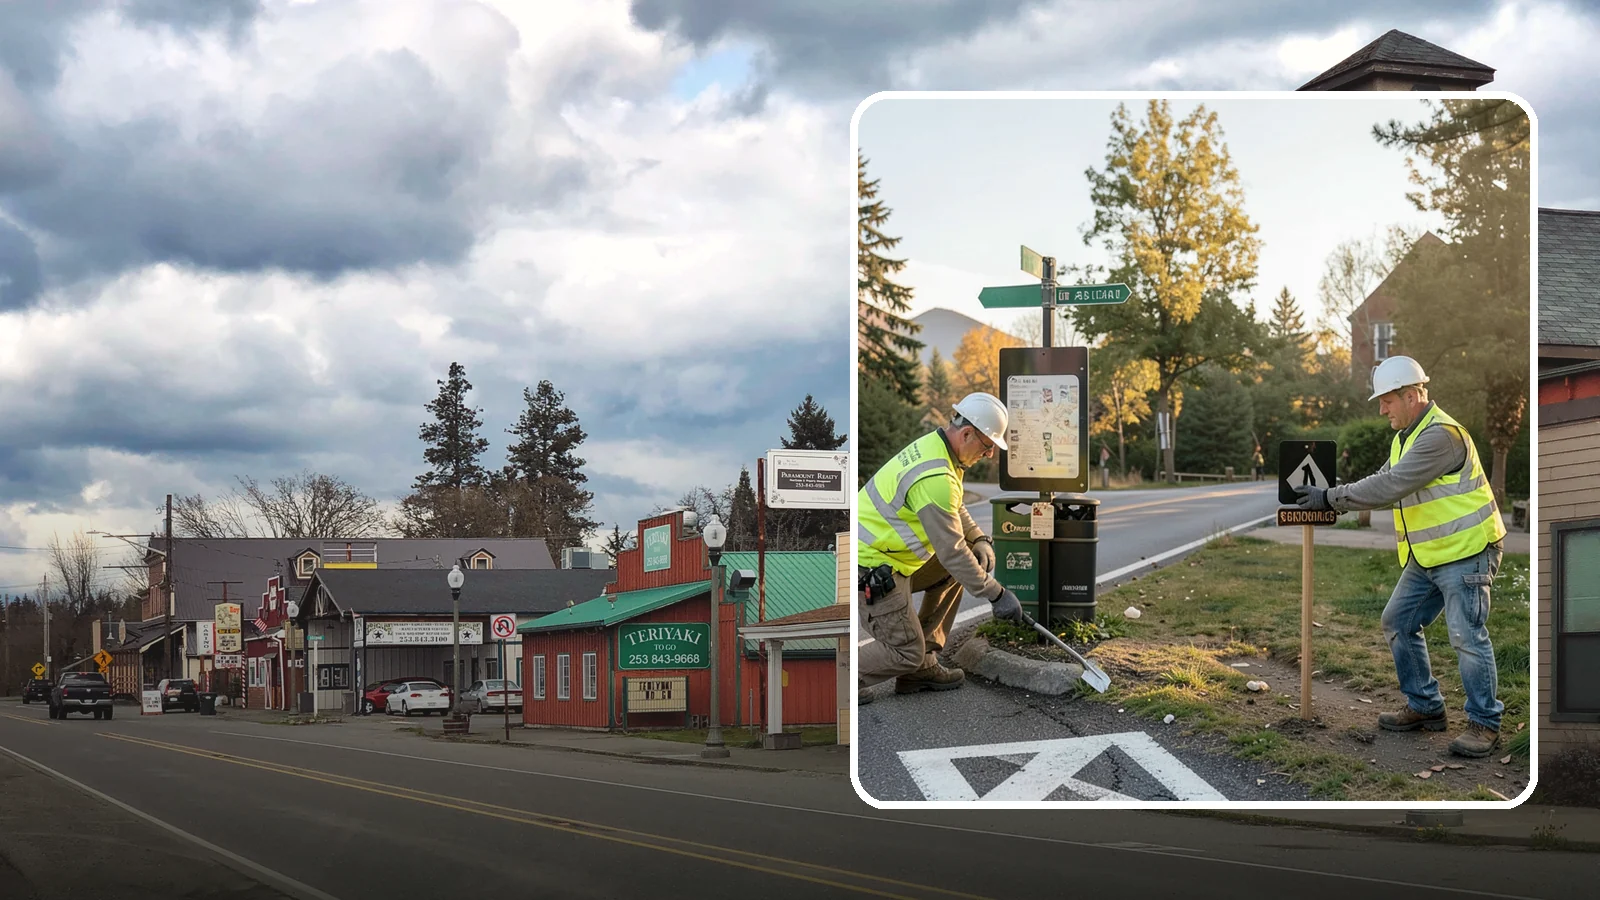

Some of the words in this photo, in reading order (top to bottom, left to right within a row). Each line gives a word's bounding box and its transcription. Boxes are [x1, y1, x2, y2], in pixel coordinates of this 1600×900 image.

[781, 471, 815, 479] PARAMOUNT
[817, 472, 839, 480] REALTY
[624, 627, 702, 646] TERIYAKI
[629, 654, 648, 665] 253
[651, 653, 700, 664] 843-9668
